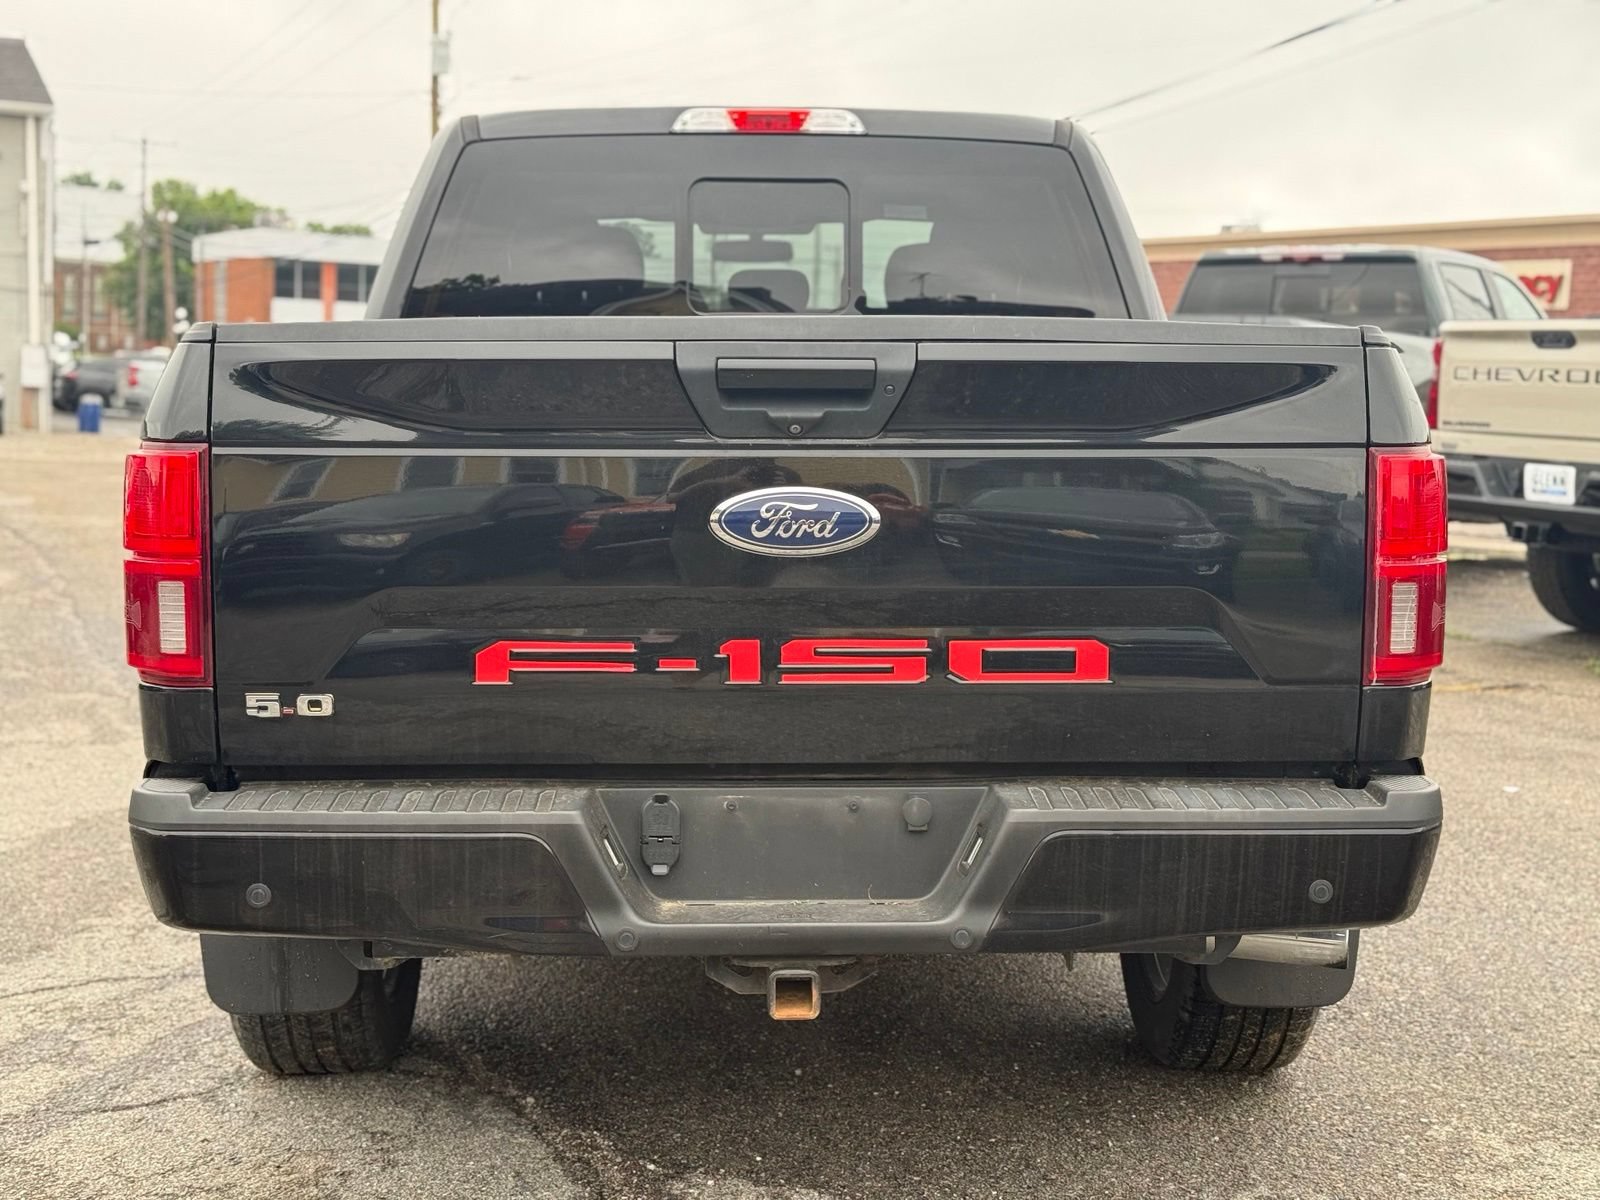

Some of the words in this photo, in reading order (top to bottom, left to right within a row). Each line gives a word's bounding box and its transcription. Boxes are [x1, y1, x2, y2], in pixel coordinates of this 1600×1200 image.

[1453, 365, 1600, 384] CHEVRO
[751, 501, 841, 538] Ford
[472, 638, 1113, 685] F-150
